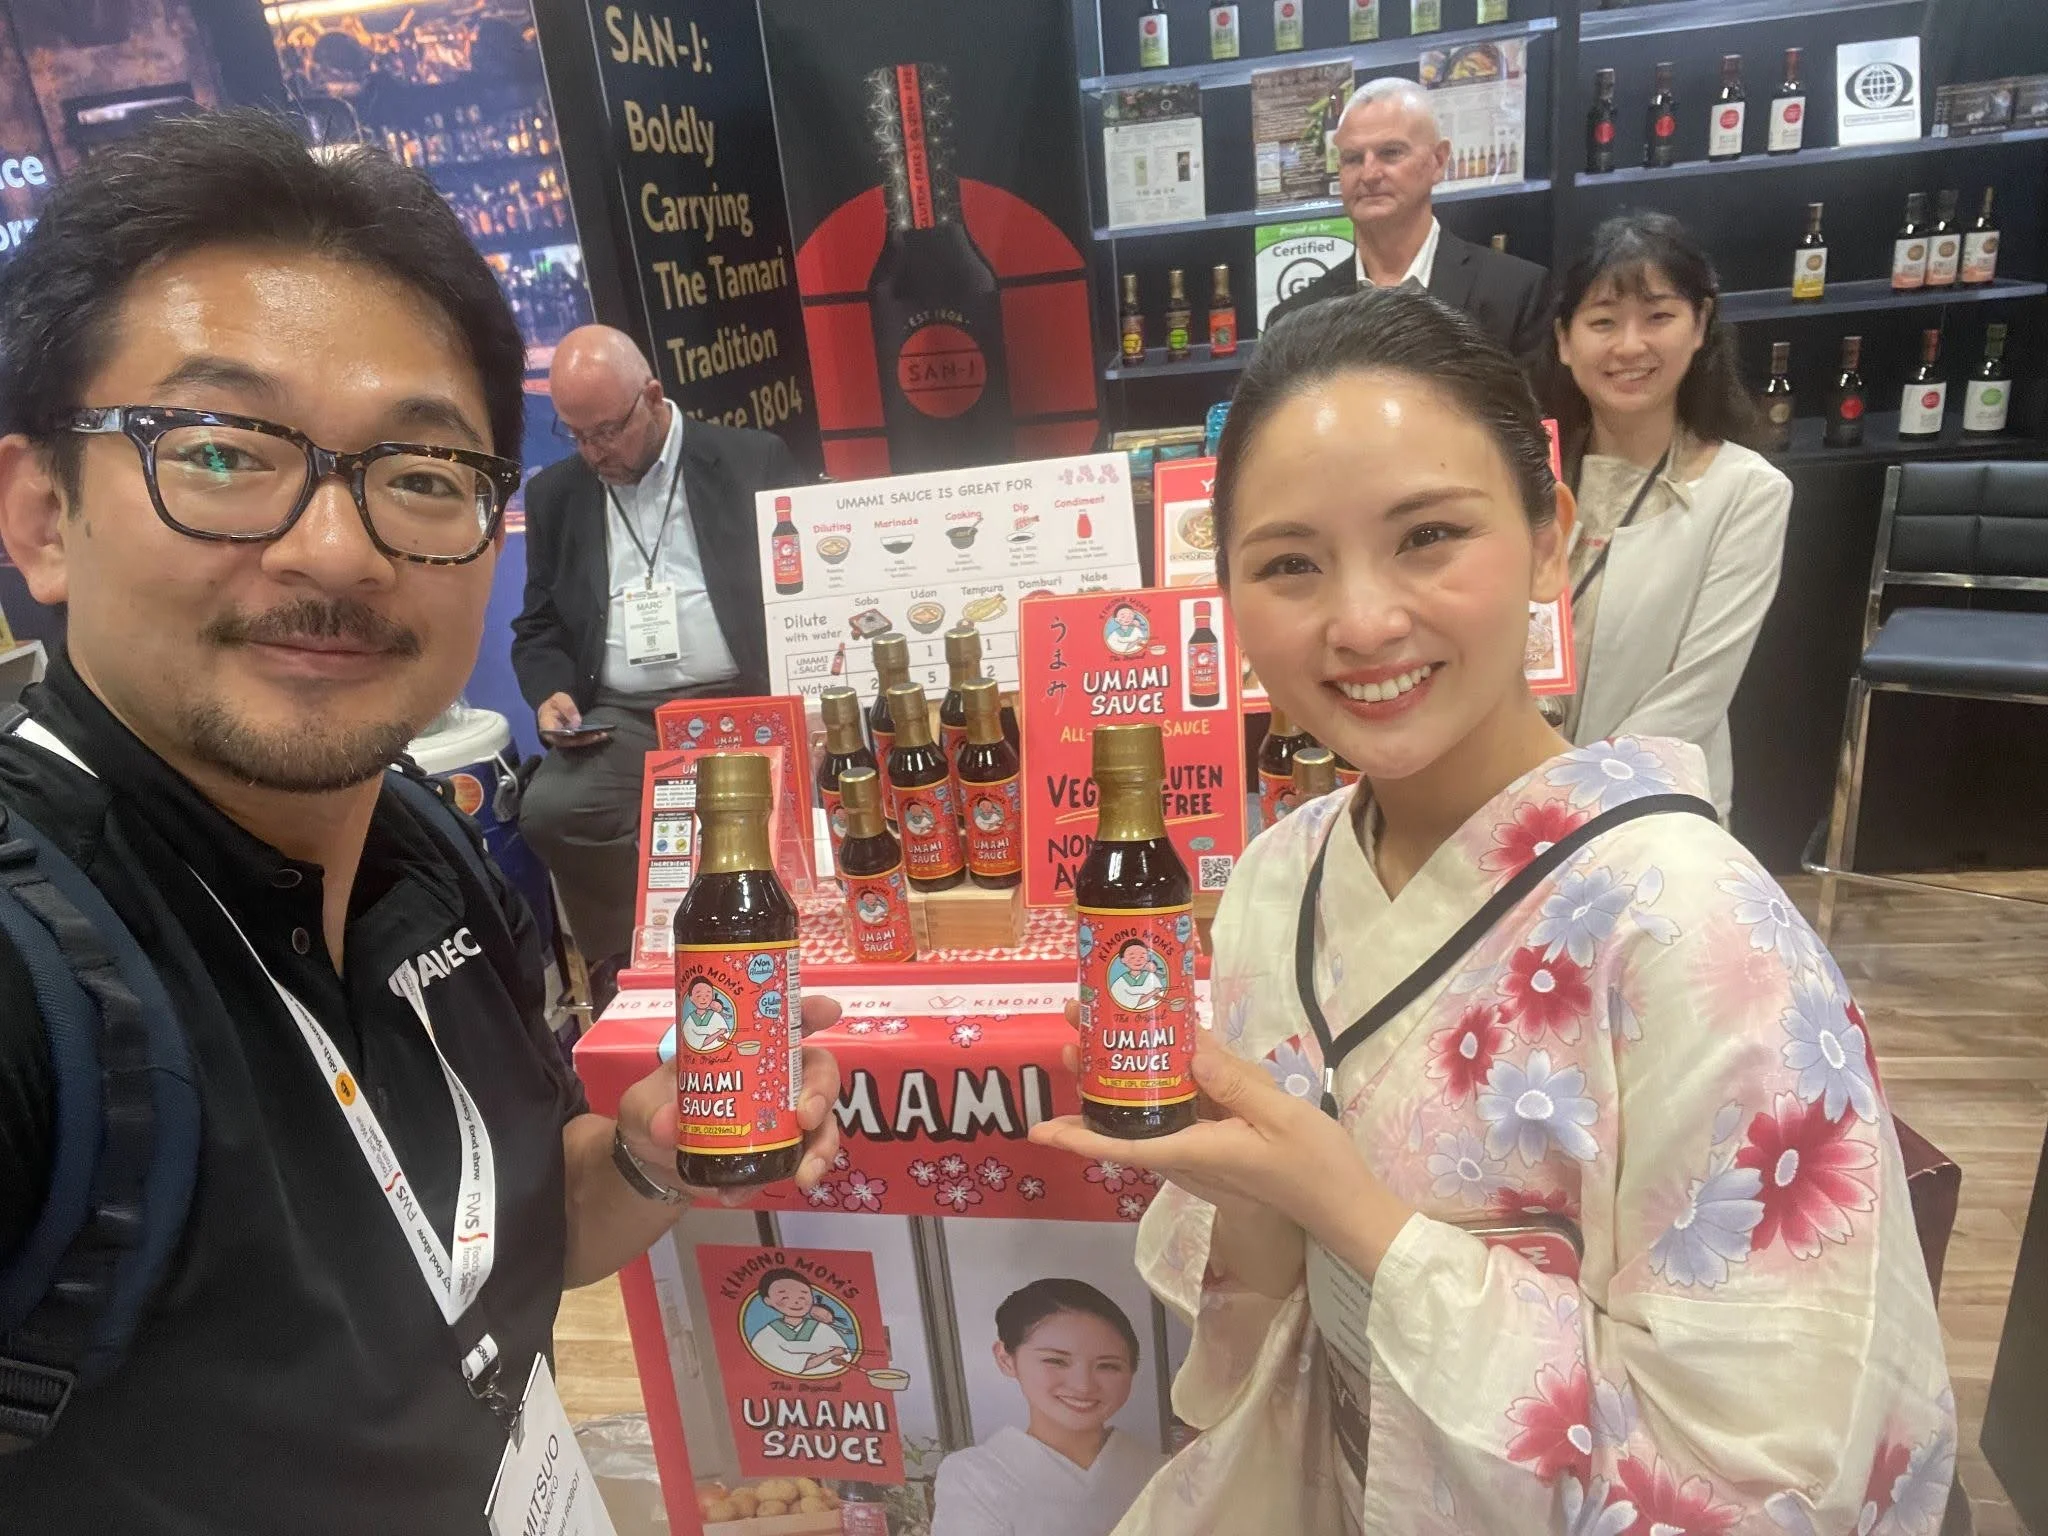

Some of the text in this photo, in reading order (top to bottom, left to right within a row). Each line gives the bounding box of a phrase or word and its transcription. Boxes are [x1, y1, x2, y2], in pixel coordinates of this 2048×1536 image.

[605, 5, 713, 75] SAN-J:
[624, 100, 715, 167] Boldly
[0, 155, 46, 191] ce
[640, 182, 754, 243] Carrying
[1272, 240, 1335, 257] Certified
[653, 246, 787, 310] The Tamari
[666, 323, 778, 386] Tradition
[749, 375, 803, 430] 1804
[837, 478, 1033, 510] UMAMI SAUCE IS GREAT FOR
[1054, 496, 1105, 509] Condiment
[945, 510, 982, 521] Cooking
[1012, 502, 1030, 514] Dip
[813, 522, 852, 534] Diluting
[854, 596, 880, 608] Soba
[911, 589, 938, 600] Udon
[961, 584, 1005, 597] Tempura
[784, 613, 828, 630] Dilute
[785, 630, 842, 643] with water
[796, 655, 829, 667] UMAMI
[799, 663, 829, 674] SAUCE
[987, 665, 995, 678] 2
[928, 671, 937, 683] 5
[1083, 665, 1171, 694] UMAMI
[1090, 691, 1166, 717] SAUCE
[1162, 718, 1211, 738] SAUCE
[1163, 764, 1223, 792] UTEN
[1047, 773, 1098, 809] VEG
[908, 840, 943, 854] UMAMI
[973, 837, 1009, 850] UMAMI
[977, 849, 1008, 860] SAUCE
[911, 852, 941, 863] SAUCE
[858, 929, 896, 942] UMAMI
[863, 940, 894, 952] SAUCE
[1098, 927, 1138, 963] KIMONO
[416, 926, 482, 988] AVEC
[753, 958, 771, 968] Non
[707, 967, 744, 996] MOM'S
[850, 1001, 892, 1009] MOM
[973, 997, 1054, 1007] KIMONO
[1103, 1025, 1176, 1050] UMAMI
[323, 1045, 338, 1074] 68th
[1110, 1052, 1170, 1072] SAUCE
[679, 1069, 743, 1094] UMAMI
[682, 1096, 737, 1118] SAUCE
[839, 1064, 1054, 1142] MAMI
[469, 1124, 479, 1150] food
[472, 1151, 481, 1181] show
[396, 1185, 418, 1222] FWS
[466, 1192, 482, 1230] FWS
[416, 1229, 433, 1254] show
[429, 1253, 445, 1278] food
[720, 1251, 860, 1300] KIMONO MOM'S
[742, 1397, 890, 1432] UMAMI
[762, 1429, 886, 1466] SAUCE
[522, 1434, 560, 1536] MITSUO
